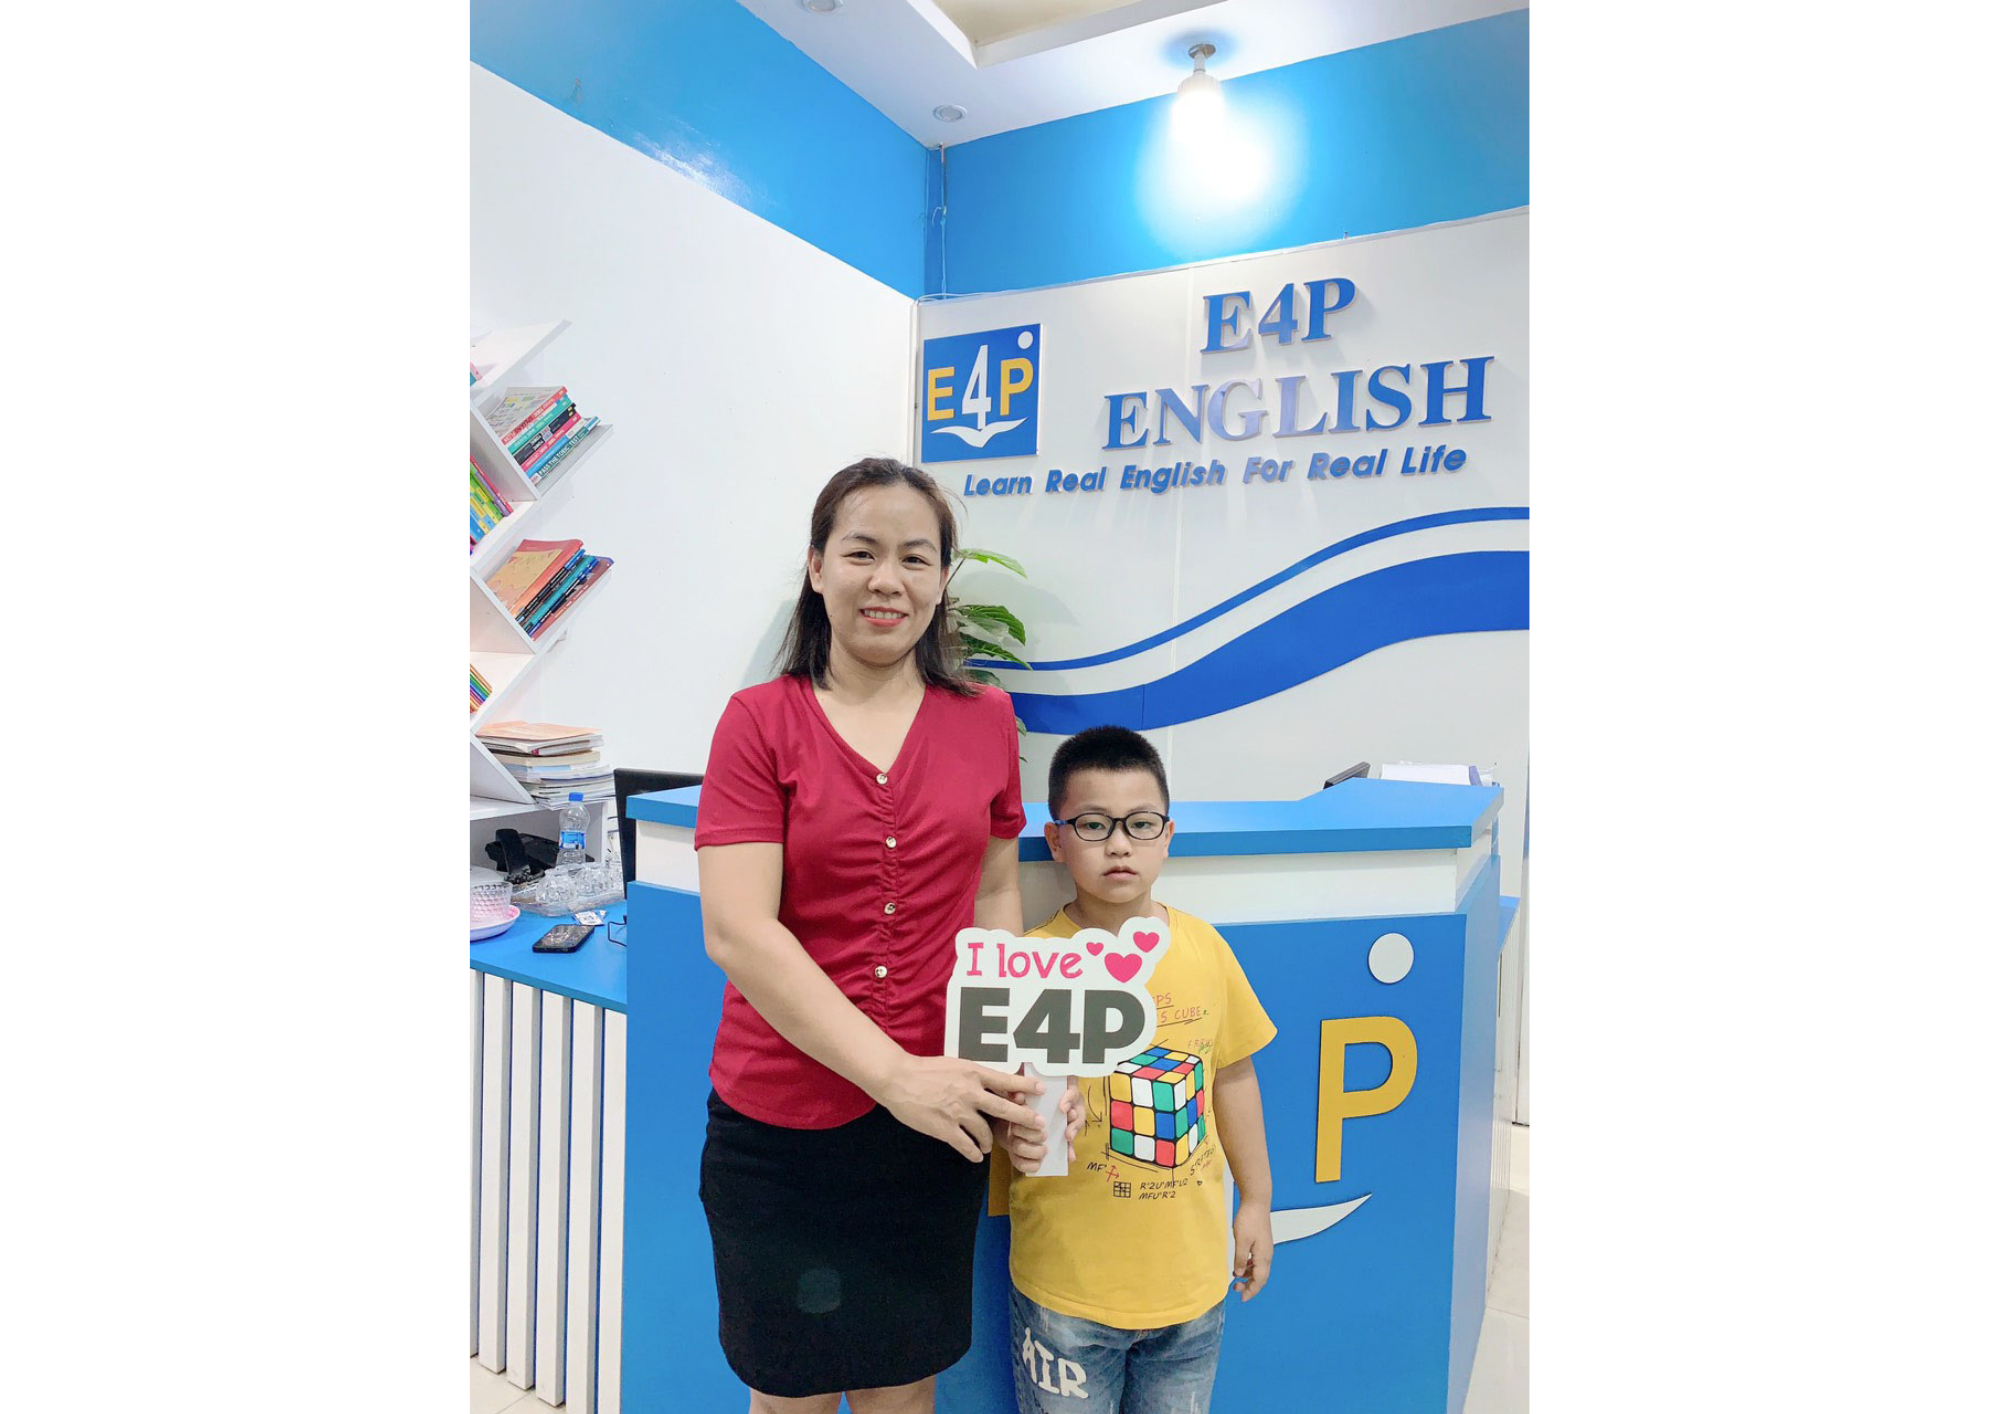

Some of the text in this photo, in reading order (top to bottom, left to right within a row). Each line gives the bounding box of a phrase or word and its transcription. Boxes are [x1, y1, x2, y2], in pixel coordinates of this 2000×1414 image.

[1200, 277, 1356, 355] E4P
[926, 344, 1034, 431] E4P
[1102, 355, 1495, 450] ENGLISH
[964, 444, 1467, 497] Learn Real English For Real Life
[966, 942, 1084, 979] I love
[1152, 992, 1172, 1006] PS
[958, 986, 1146, 1065] E4P
[1314, 1016, 1418, 1184] P
[1022, 1327, 1089, 1399] AIR
